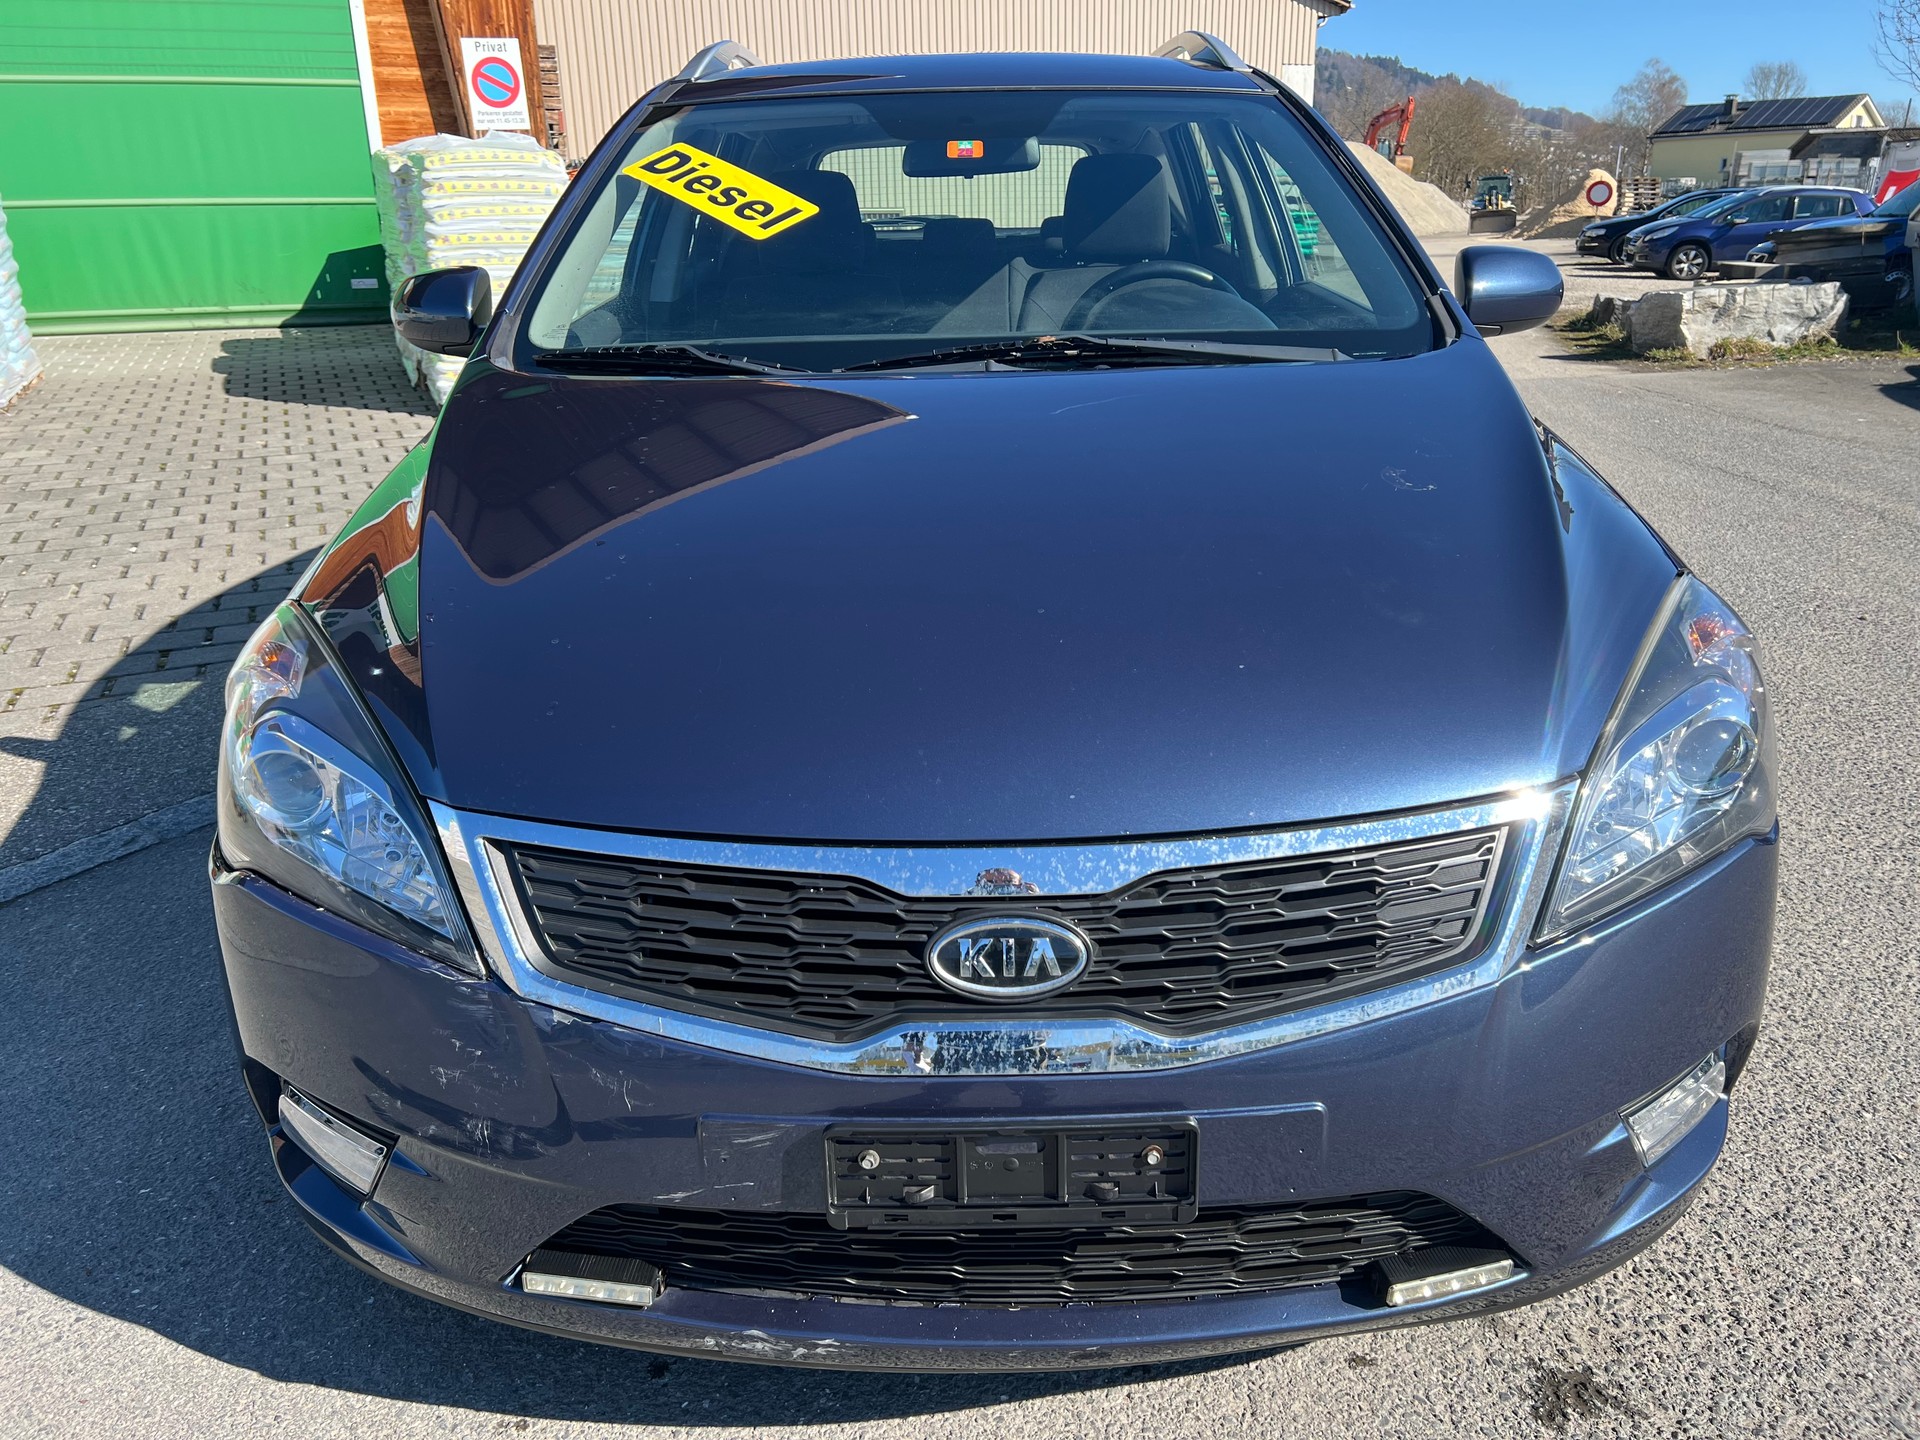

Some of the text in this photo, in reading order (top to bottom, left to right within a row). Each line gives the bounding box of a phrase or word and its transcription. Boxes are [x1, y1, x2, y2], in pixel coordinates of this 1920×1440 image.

[474, 41, 507, 53] Privat
[637, 149, 804, 231] Diesel
[957, 937, 1062, 978] KIA
